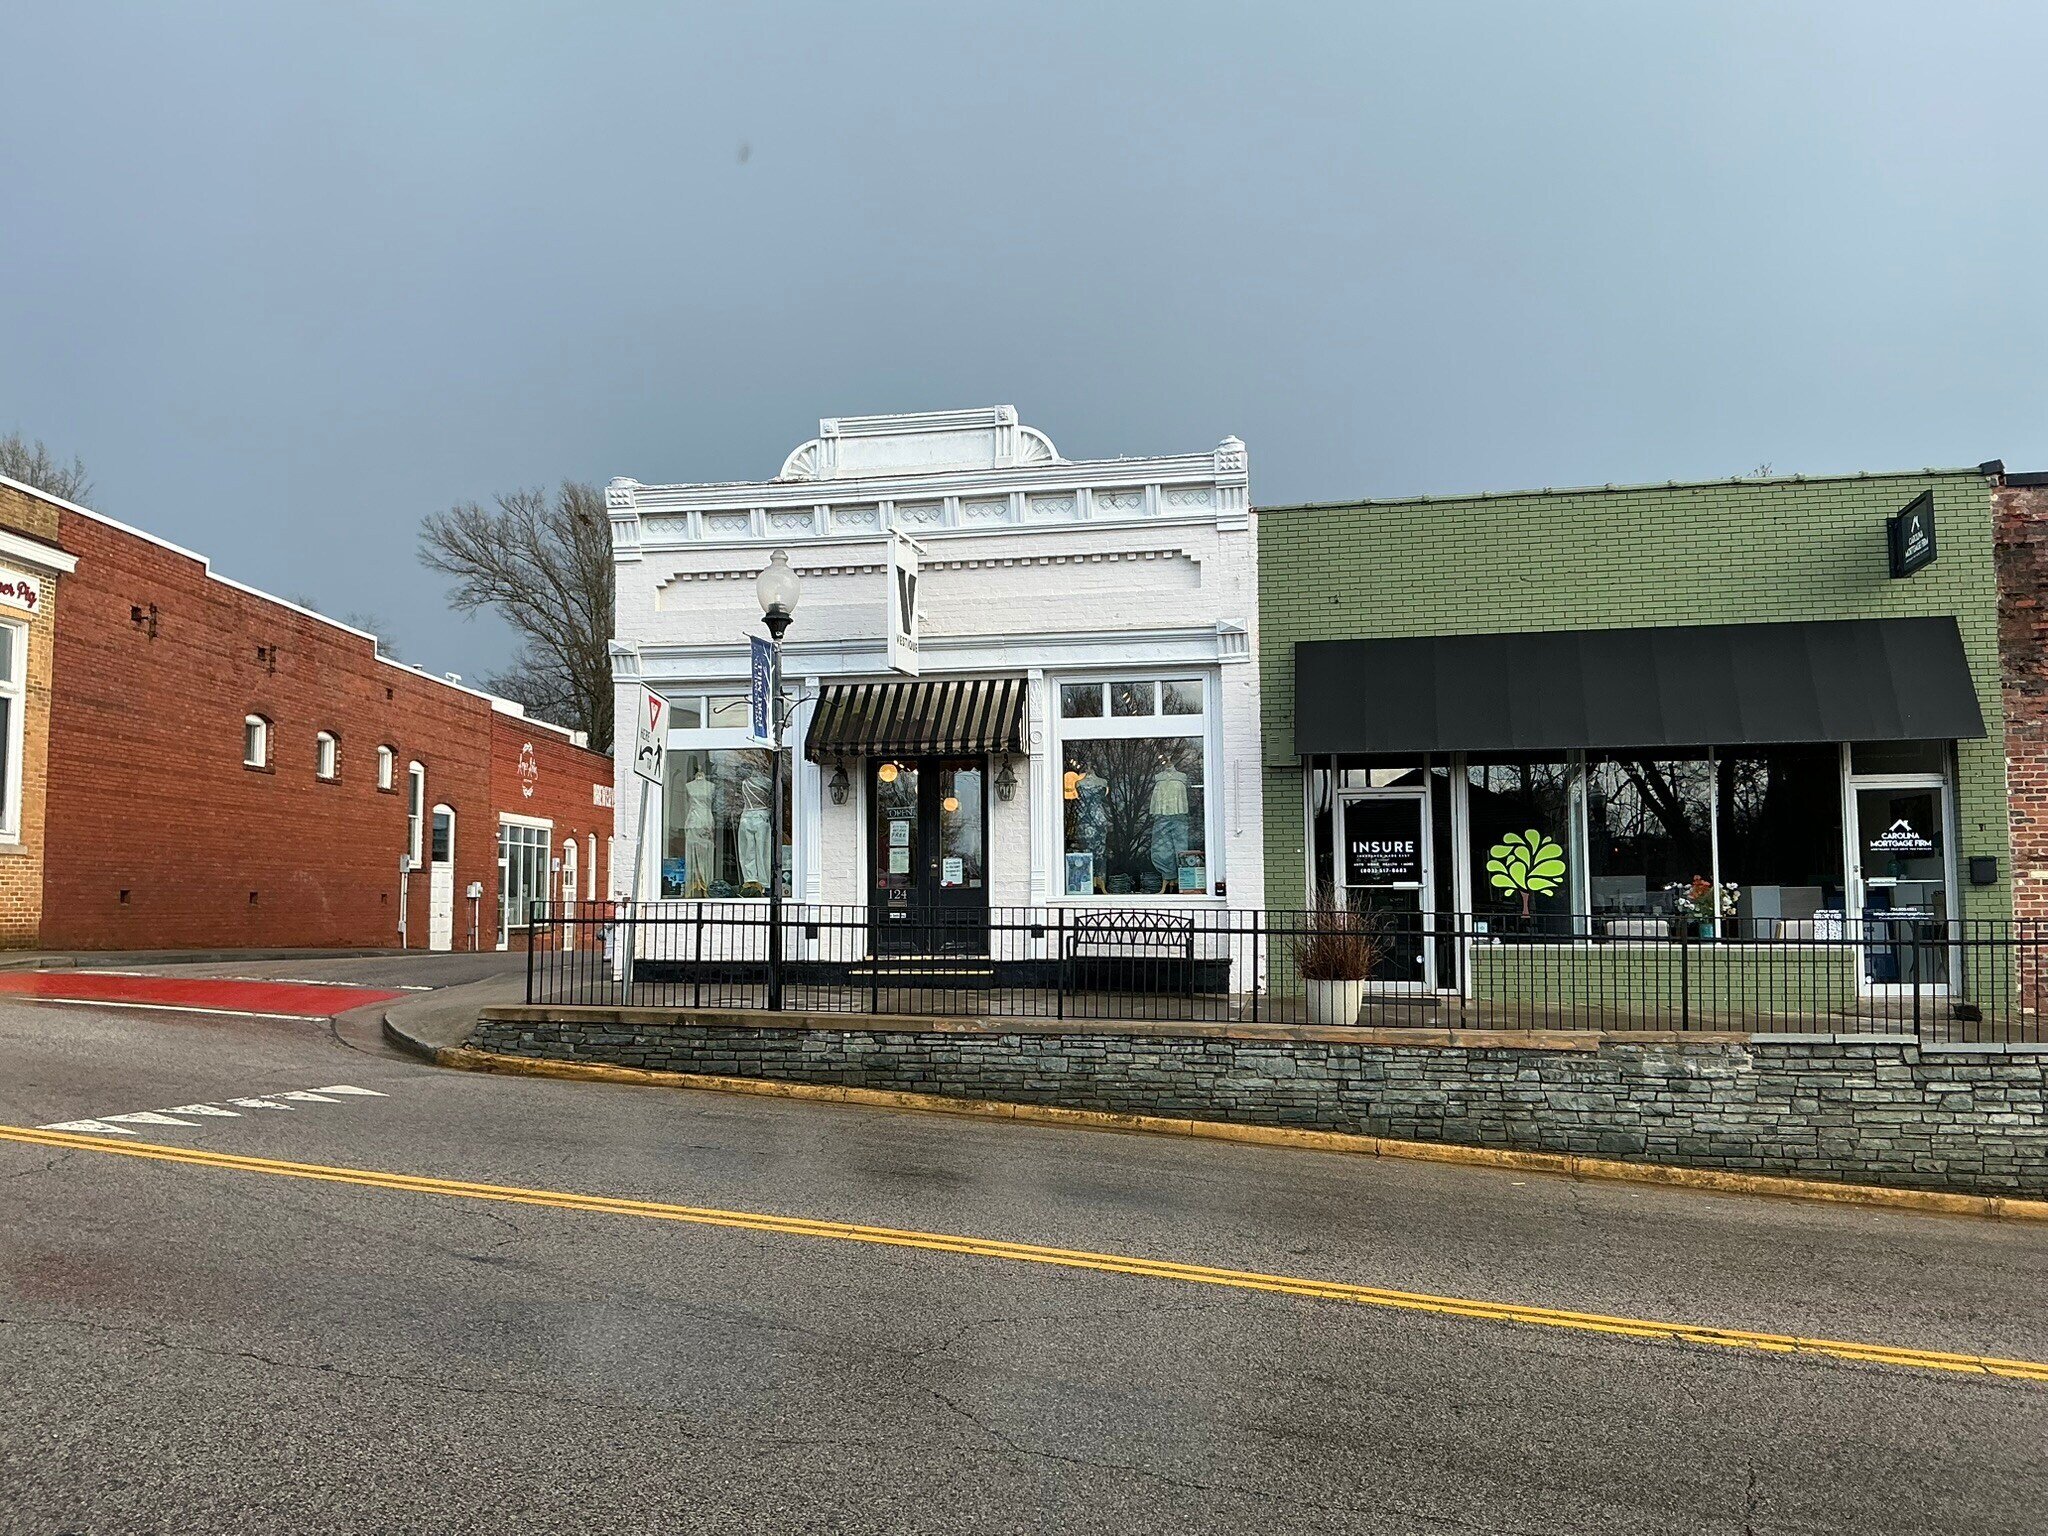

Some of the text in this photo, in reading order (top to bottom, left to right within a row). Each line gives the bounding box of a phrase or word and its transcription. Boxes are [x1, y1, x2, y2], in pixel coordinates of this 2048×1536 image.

[17, 581, 37, 609] Pig
[896, 564, 917, 636] V
[889, 808, 914, 817] OPEN
[1353, 841, 1414, 853] INSURE
[889, 890, 907, 900] 124
